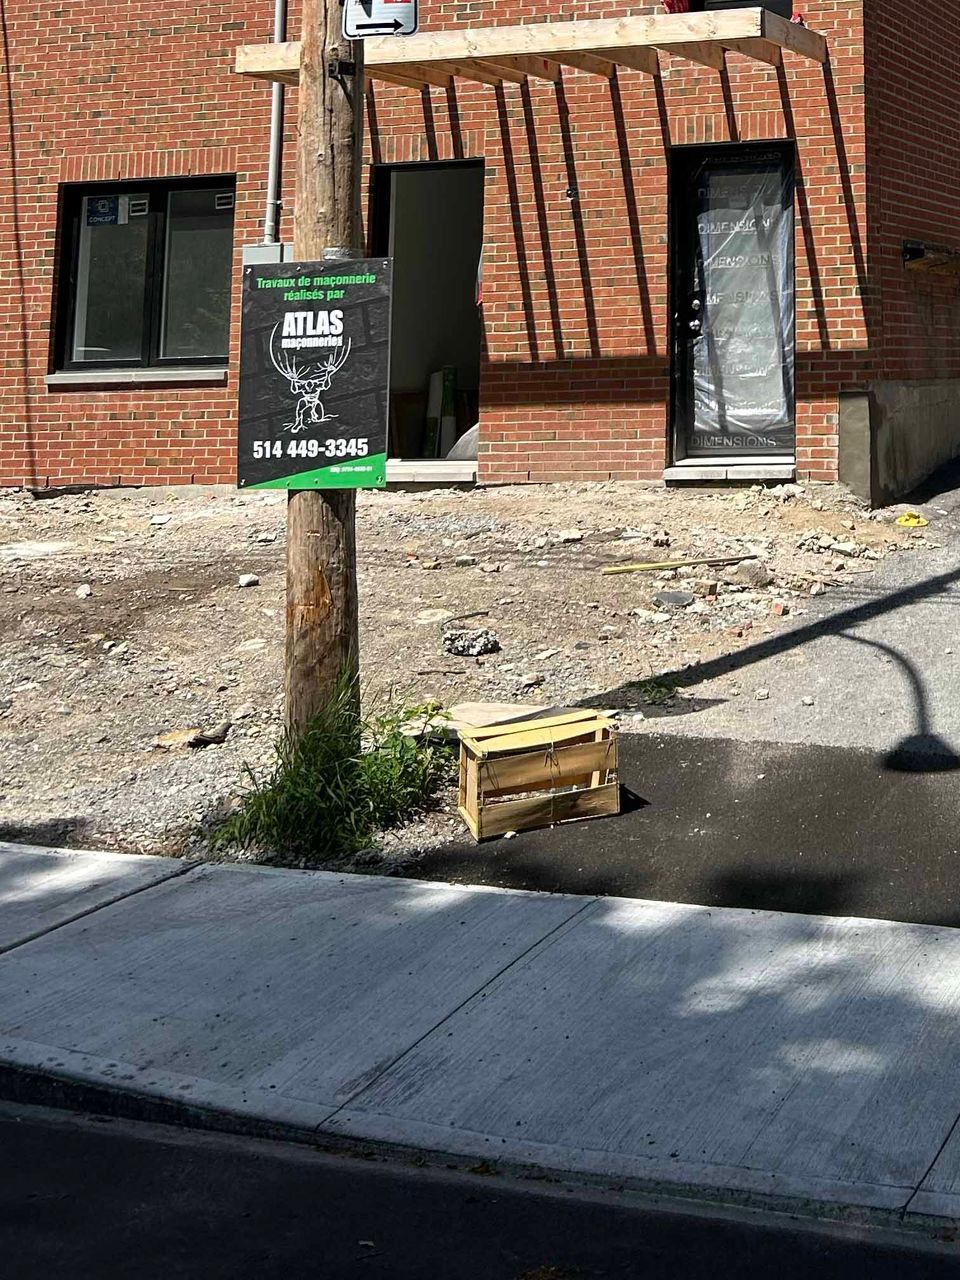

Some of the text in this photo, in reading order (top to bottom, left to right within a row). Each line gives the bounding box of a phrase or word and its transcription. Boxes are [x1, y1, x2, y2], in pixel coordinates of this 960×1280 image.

[256, 273, 376, 288] Travaux de maçonnerie
[283, 289, 345, 301] réalisés par
[282, 309, 344, 337] ATLAS
[253, 438, 369, 458] 514 449-3345
[691, 435, 777, 448] DIMENSIONS
